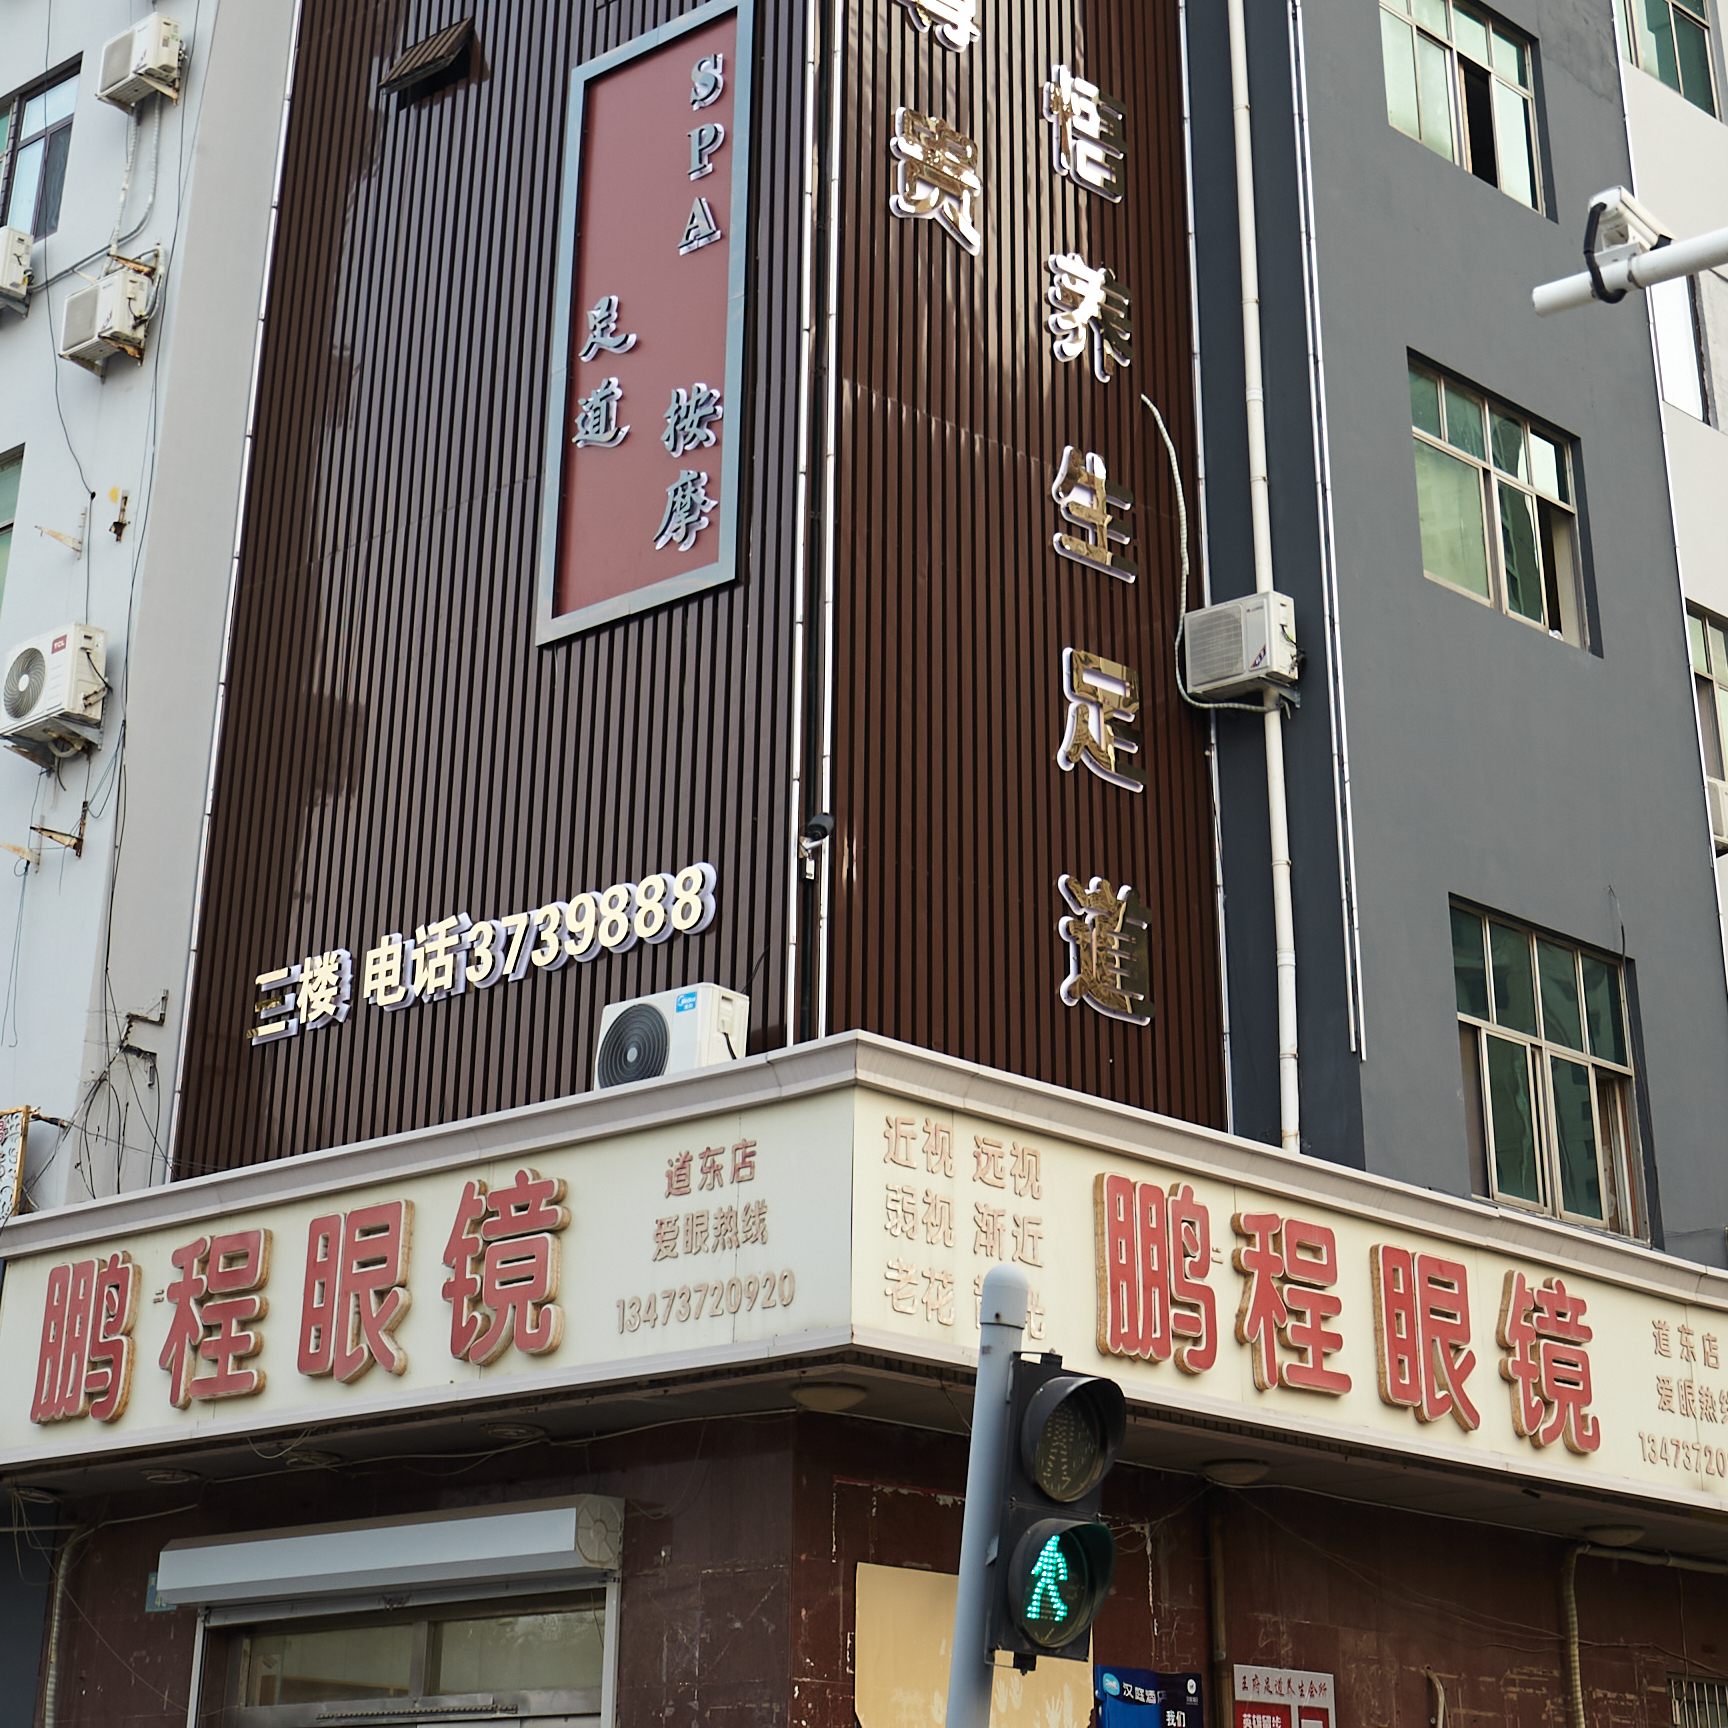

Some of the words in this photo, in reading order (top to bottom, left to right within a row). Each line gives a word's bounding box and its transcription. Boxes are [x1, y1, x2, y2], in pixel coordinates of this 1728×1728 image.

[677, 52, 726, 256] SPA
[572, 294, 638, 449] 足道
[653, 382, 725, 552] 按摩
[247, 948, 352, 1046] 三楼
[363, 861, 718, 1012] 电话3739888
[664, 1138, 758, 1199] 道东店
[883, 1115, 955, 1179] 近视
[973, 1134, 1043, 1200] 远视
[652, 1198, 769, 1262] 爱眼热线
[884, 1183, 955, 1248] 弱视
[973, 1201, 1044, 1268] 渐近
[29, 1167, 574, 1426] 鹏程眼镜
[616, 1268, 796, 1335] 13473720920
[884, 1257, 955, 1327] 老花
[1093, 1170, 1604, 1457] 鹏程眼镜
[1652, 1319, 1720, 1370] 道东店
